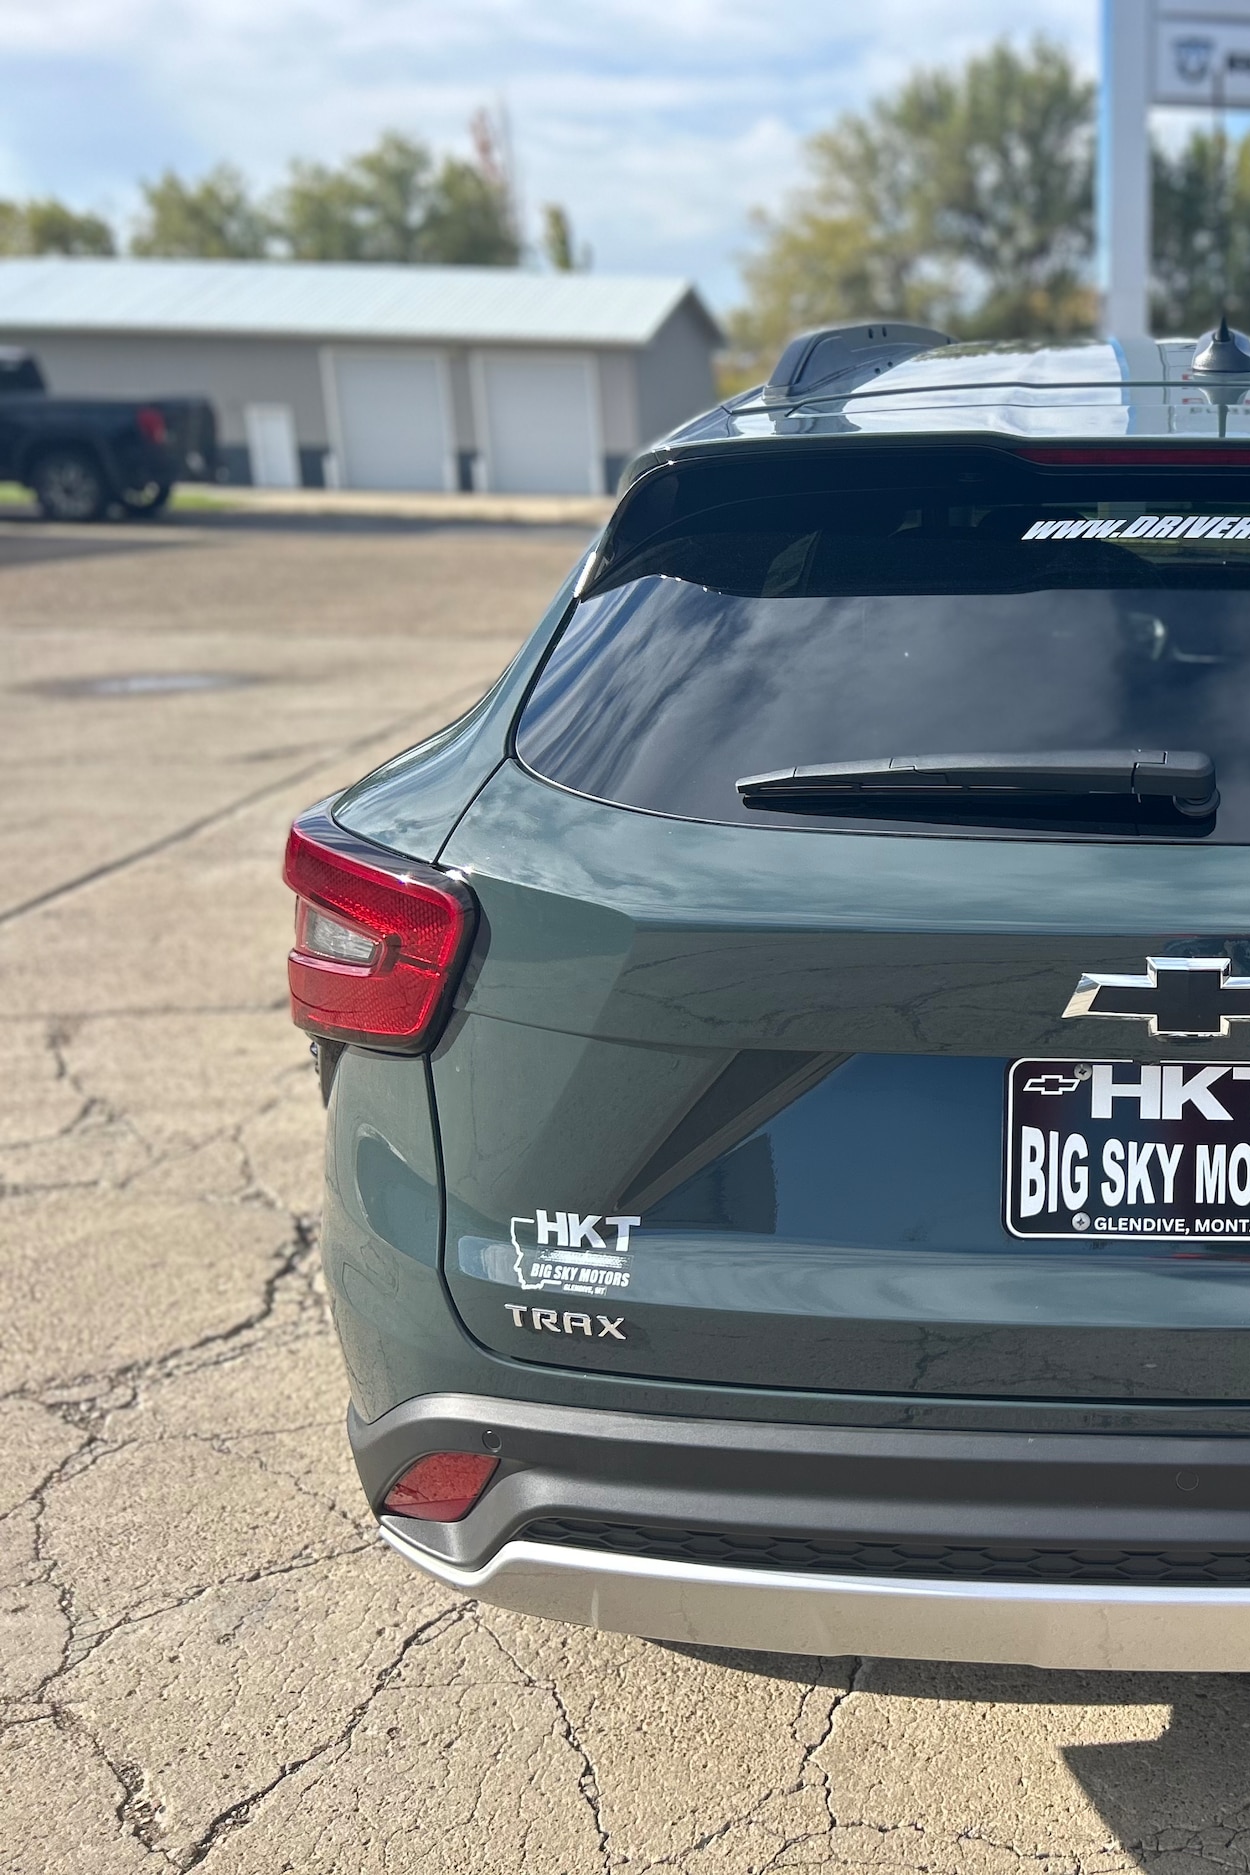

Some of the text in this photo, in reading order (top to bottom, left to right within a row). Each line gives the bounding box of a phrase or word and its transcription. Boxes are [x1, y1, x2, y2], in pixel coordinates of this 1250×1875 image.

[1019, 1125, 1089, 1219] BIG
[1100, 1137, 1185, 1207] SKY
[535, 1208, 642, 1252] HKT
[1093, 1216, 1190, 1236] GLENDIVE,
[530, 1262, 631, 1288] BIG SKY MOTORS
[503, 1303, 627, 1340] TRAX
